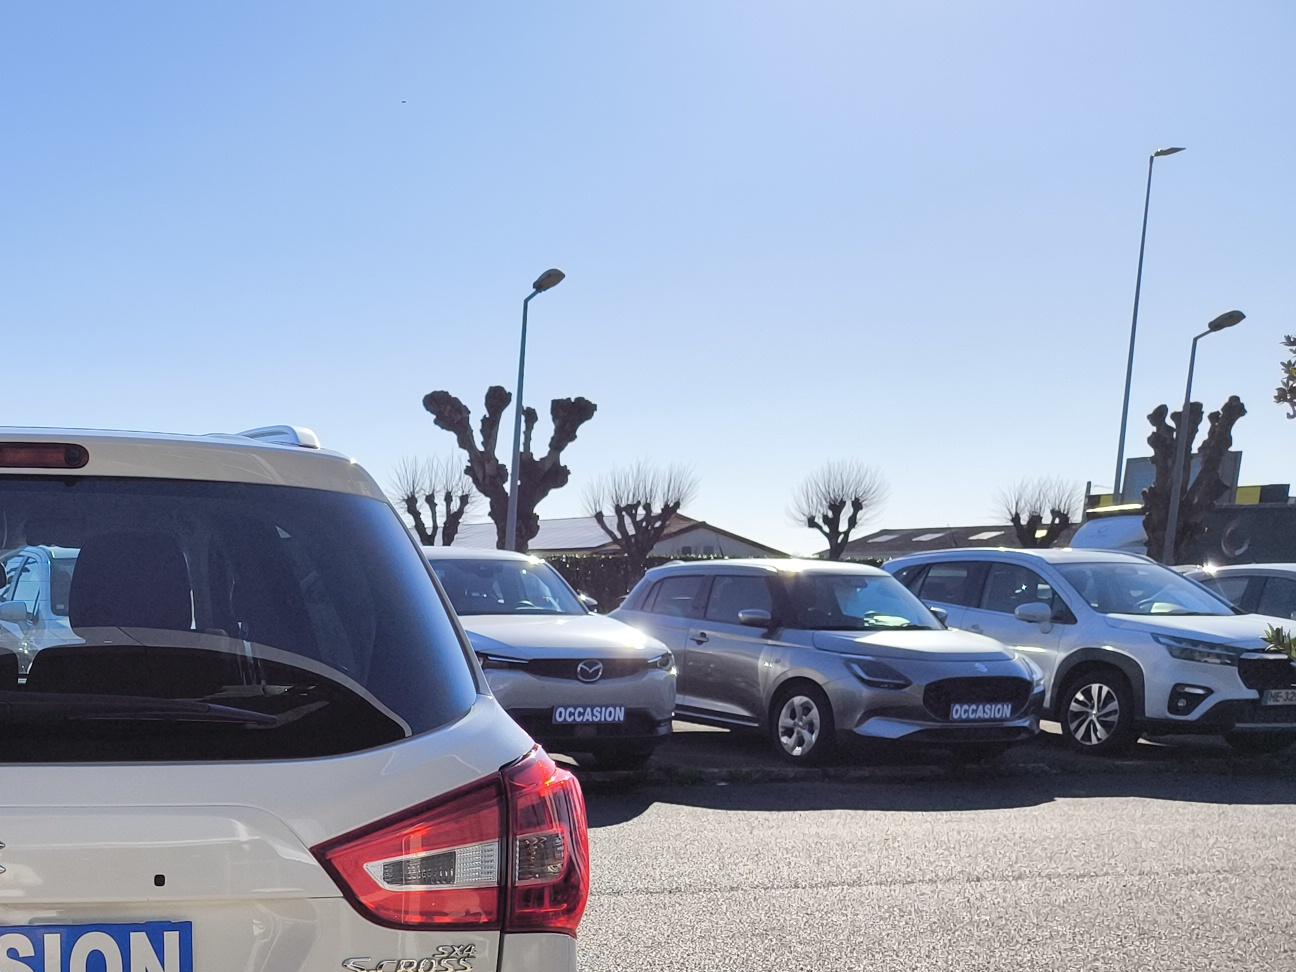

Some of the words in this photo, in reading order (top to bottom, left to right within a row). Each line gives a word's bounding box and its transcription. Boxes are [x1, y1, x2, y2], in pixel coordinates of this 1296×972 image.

[555, 706, 624, 722] OCCASION
[952, 704, 1012, 719] OCCASION
[432, 943, 476, 959] SX4
